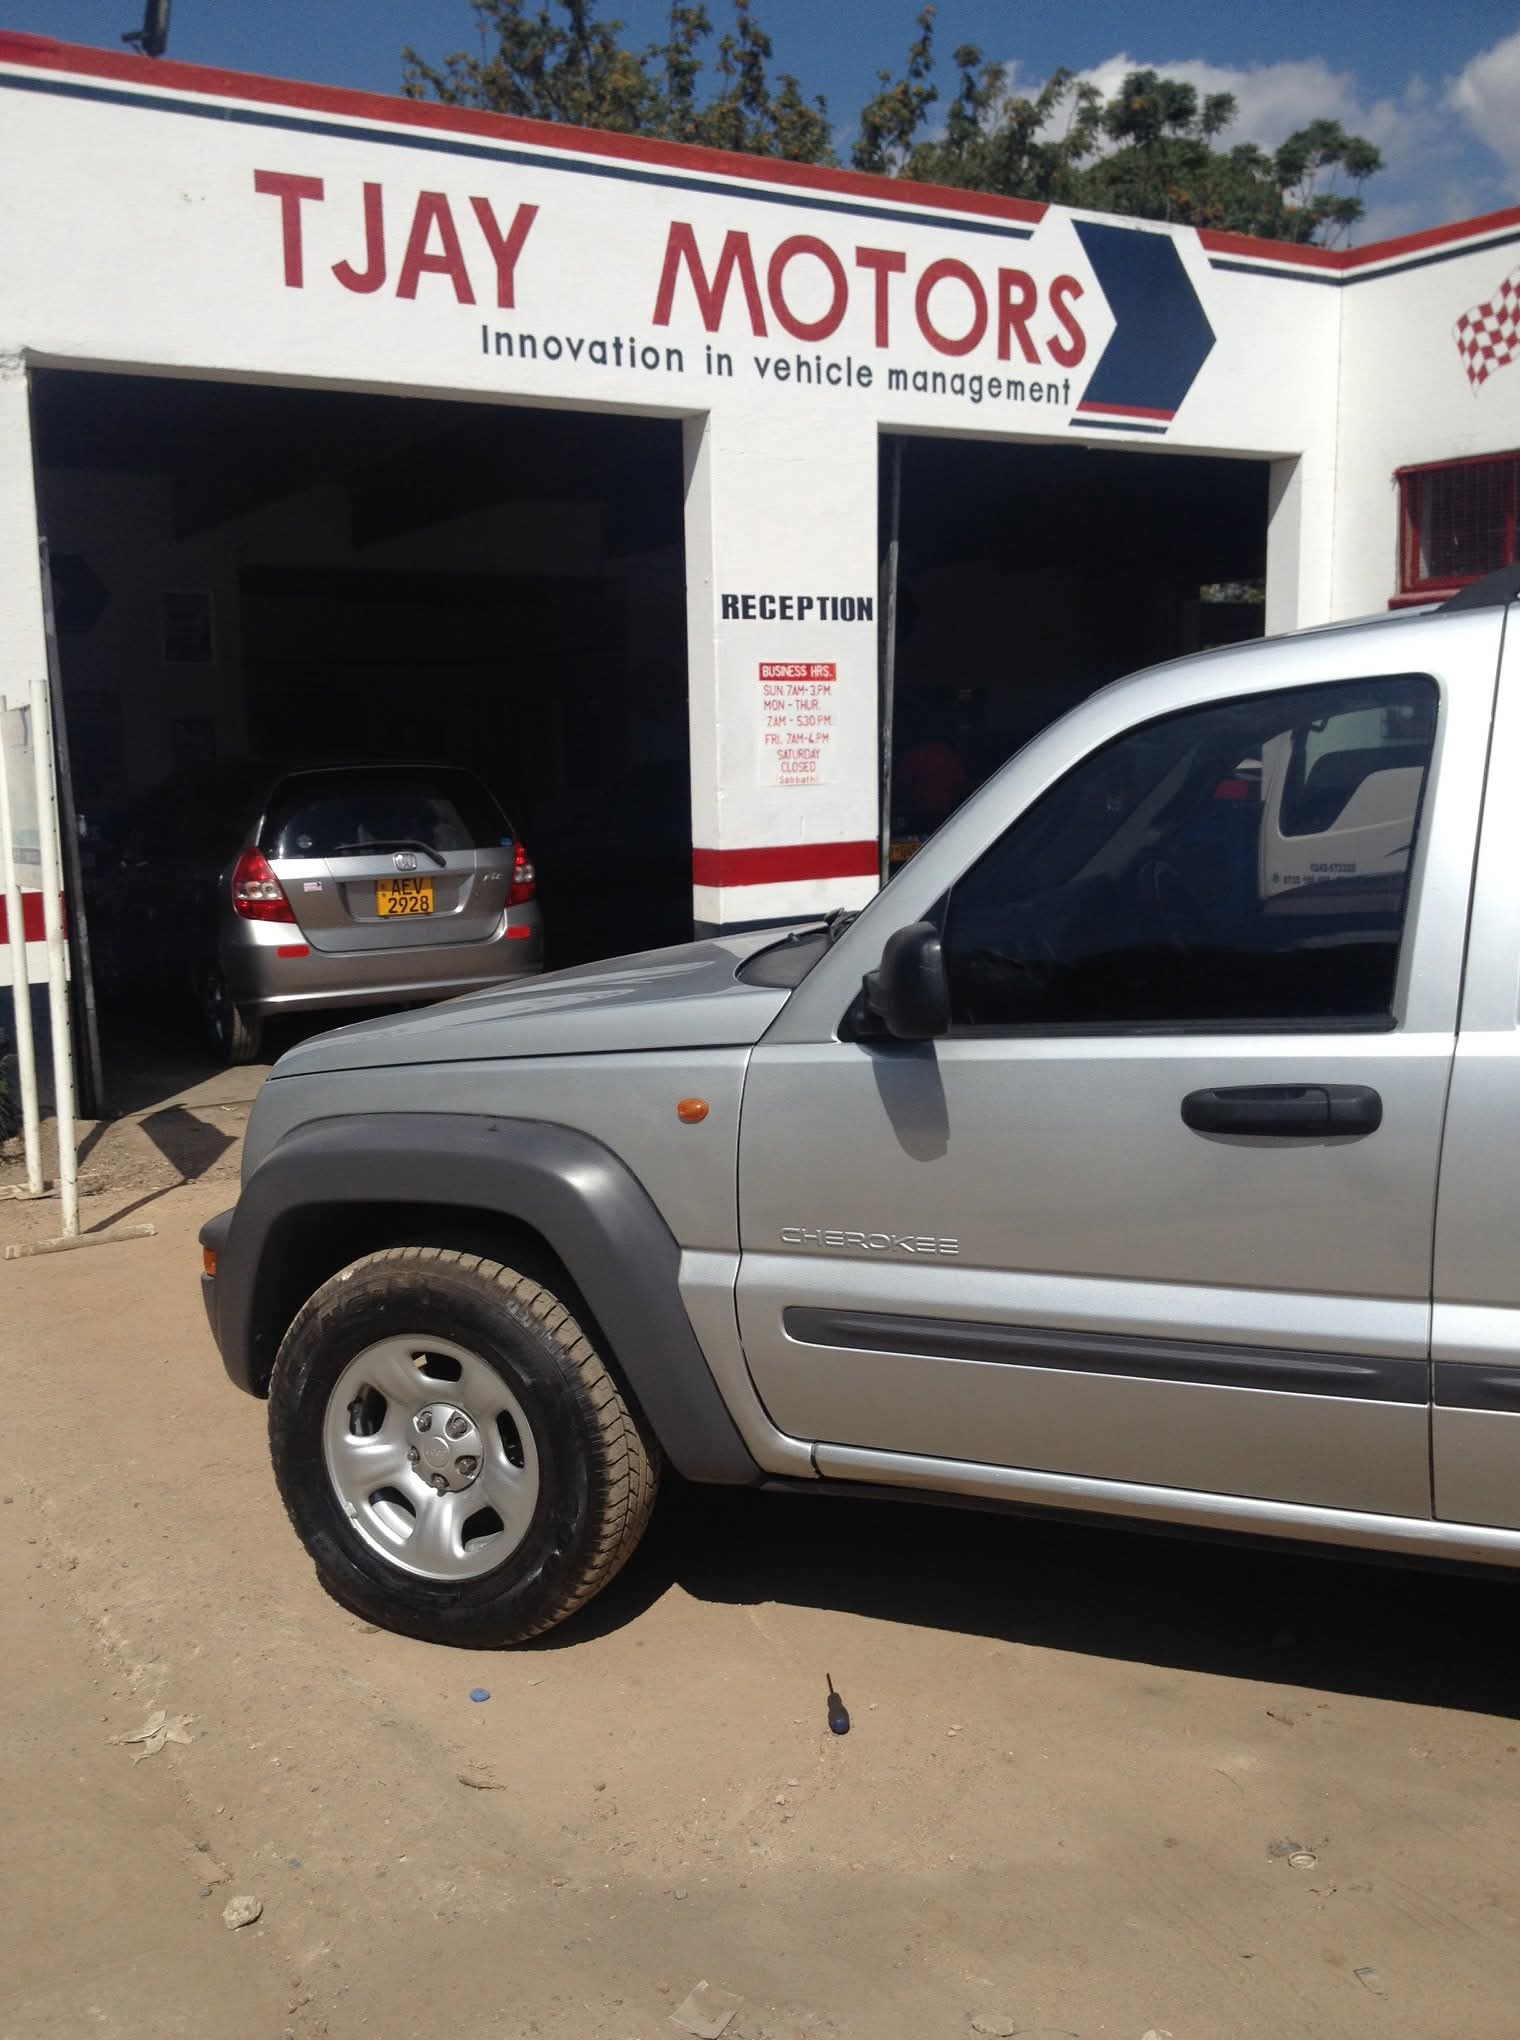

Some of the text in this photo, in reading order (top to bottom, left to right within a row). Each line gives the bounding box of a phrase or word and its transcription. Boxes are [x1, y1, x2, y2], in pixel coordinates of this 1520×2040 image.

[253, 168, 1087, 368] TJAY MOTORS
[481, 324, 1071, 405] Innovation in vehicle management
[721, 593, 873, 622] RECEPTION
[762, 664, 807, 678] BUSINESS
[763, 699, 785, 711] MON
[776, 749, 821, 760] SATURDAY
[780, 761, 817, 773] CLOSED
[391, 878, 423, 896] AEV
[388, 895, 429, 914] 2928
[780, 1227, 960, 1256] CHEROKEE
